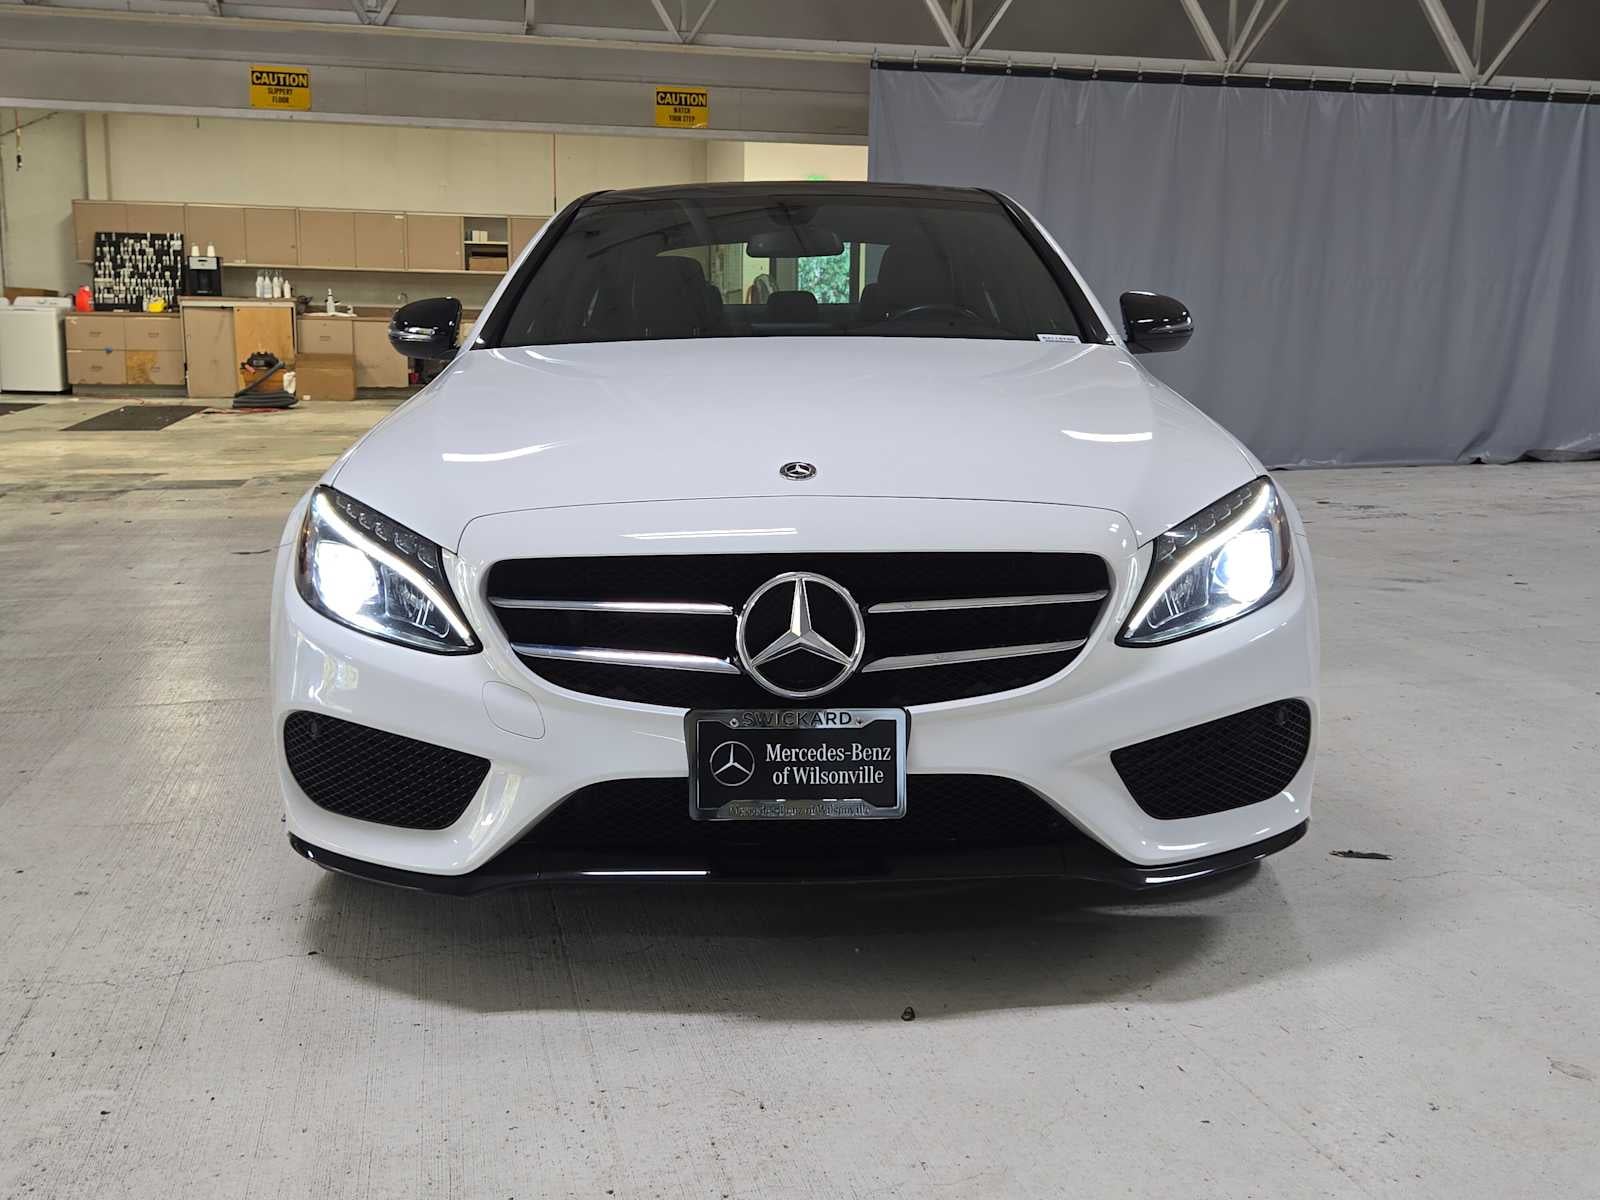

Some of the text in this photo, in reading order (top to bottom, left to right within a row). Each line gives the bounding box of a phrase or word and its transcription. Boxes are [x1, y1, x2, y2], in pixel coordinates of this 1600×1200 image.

[252, 71, 308, 87] CAUTION
[267, 87, 293, 96] SLIPPERY
[657, 92, 706, 106] CAUTION
[272, 96, 289, 104] FLOOR
[742, 711, 853, 727] SWICKARD
[765, 743, 892, 762] Mercedes-Benz
[772, 765, 885, 786] of Wilsonville
